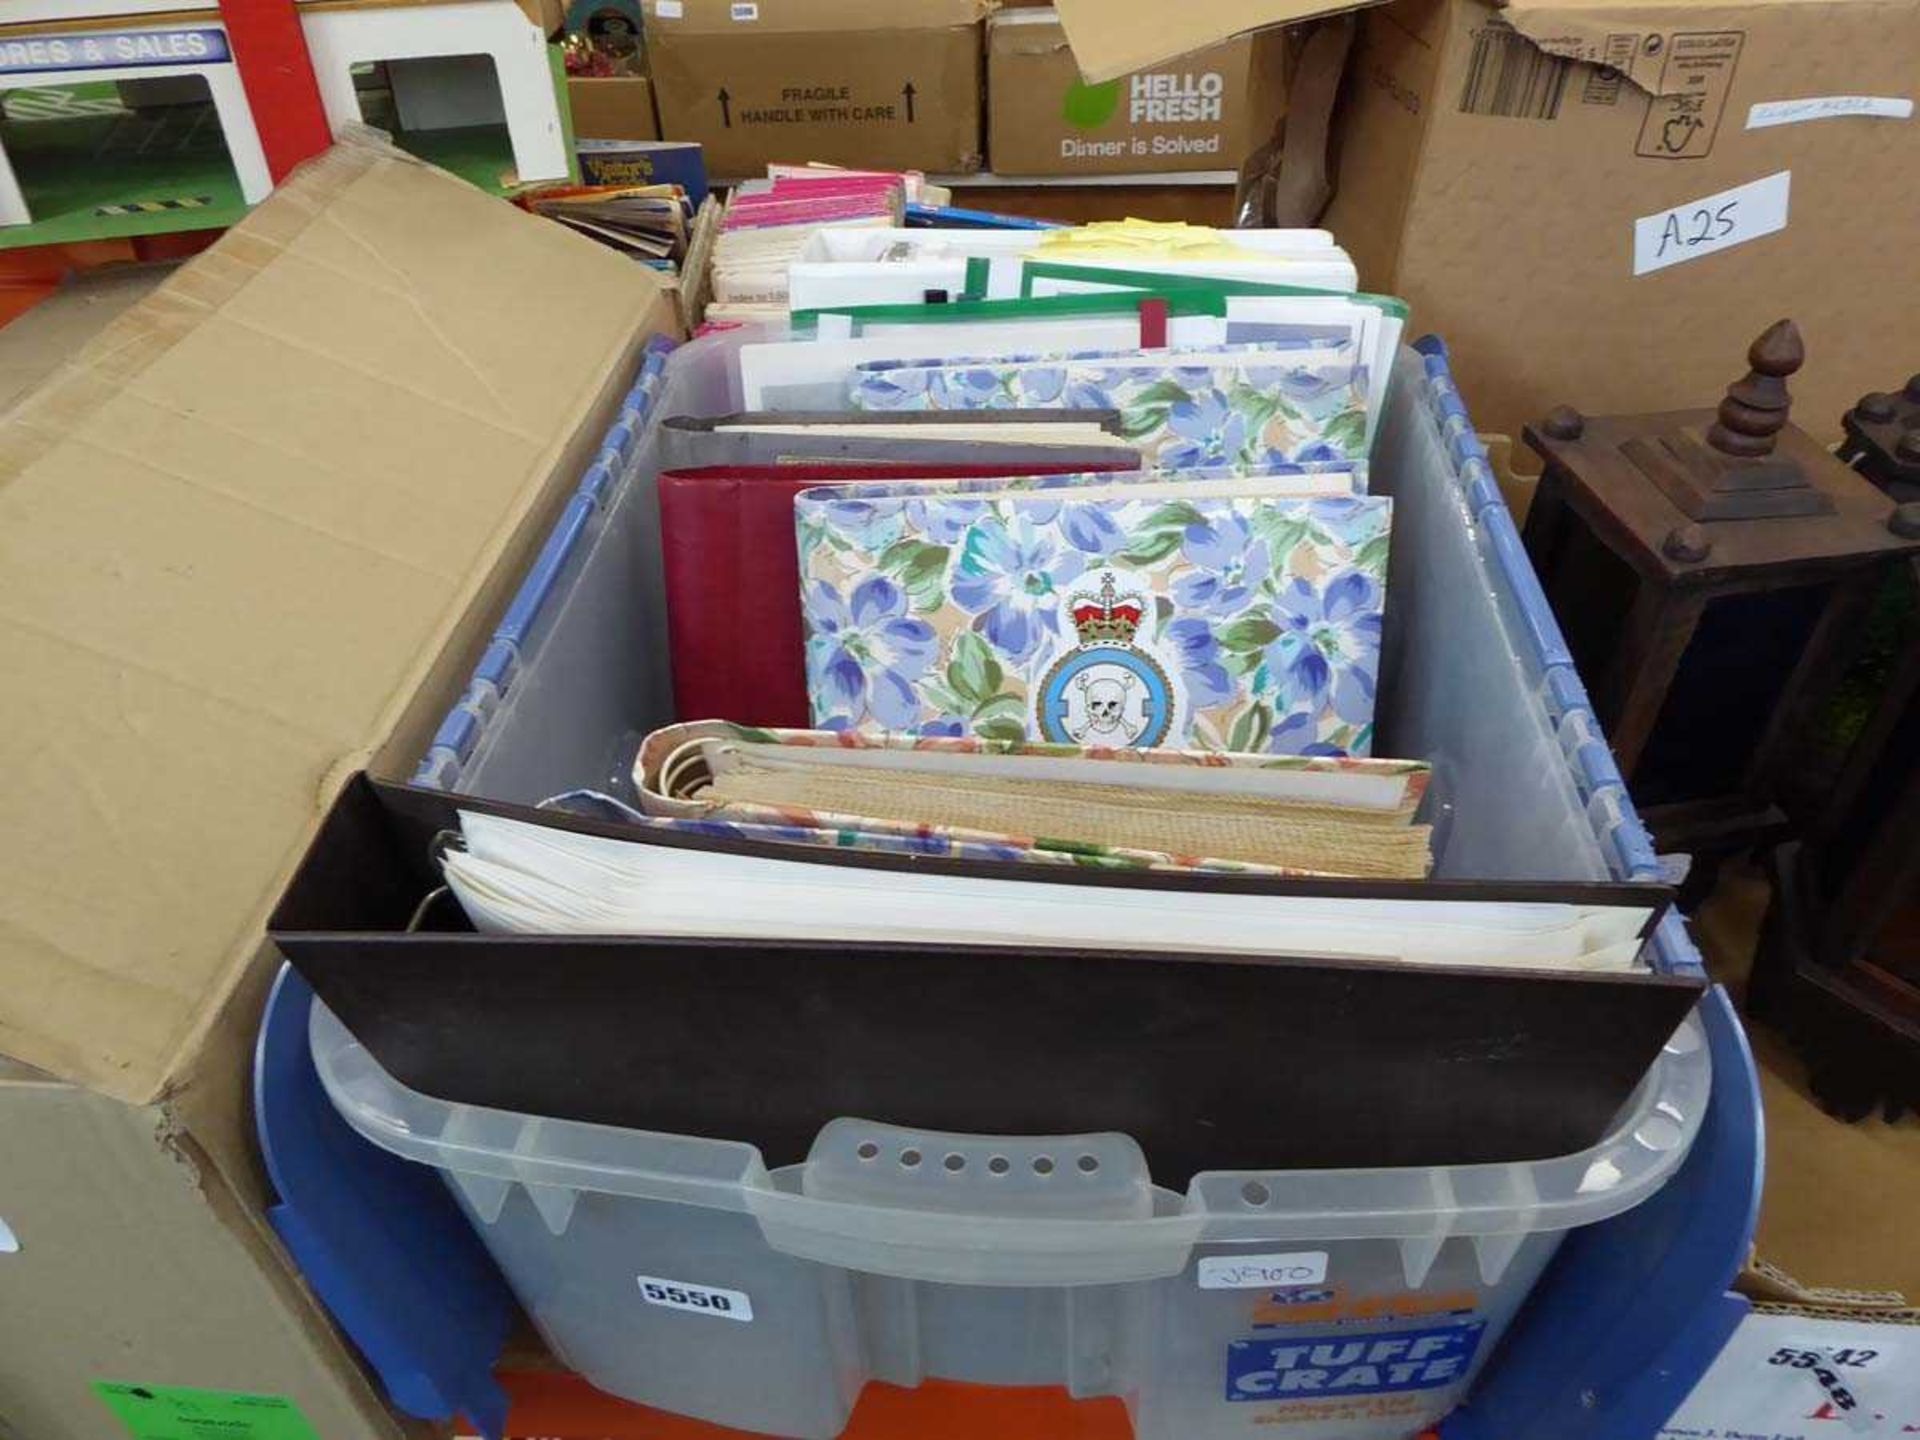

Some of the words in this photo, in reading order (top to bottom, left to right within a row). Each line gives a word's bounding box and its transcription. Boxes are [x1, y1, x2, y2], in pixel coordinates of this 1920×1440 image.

[83, 39, 105, 61] &
[115, 32, 207, 59] SALES
[782, 86, 849, 101] FRAGILE
[1130, 73, 1223, 98] HELLO
[741, 108, 805, 123] HANDLE
[808, 107, 848, 121] WITH
[852, 105, 897, 120] CARE
[1130, 98, 1222, 123] FRESH
[1061, 138, 1127, 157] Dinner
[1131, 137, 1147, 154] is
[1152, 133, 1219, 155] Solved
[1656, 201, 1738, 257] A25
[644, 1283, 731, 1311] 5550
[1270, 1335, 1453, 1370] TUFF
[1235, 1356, 1465, 1393] CRATE
